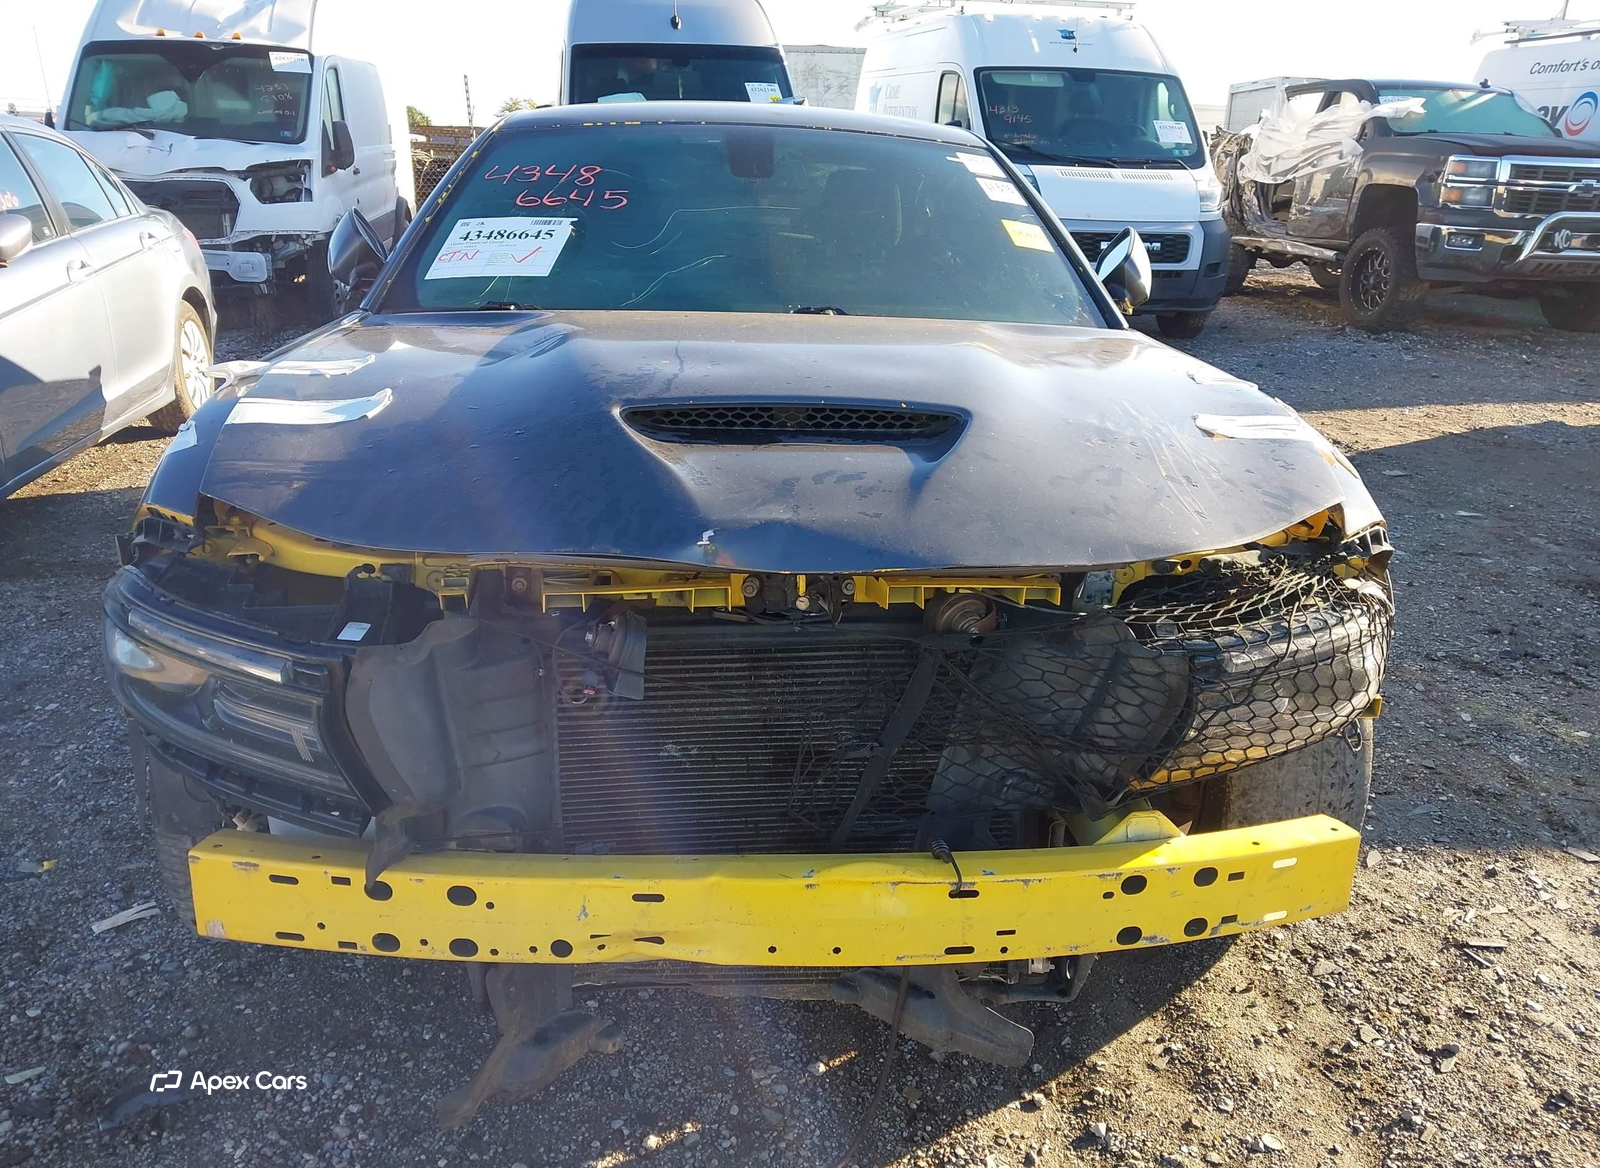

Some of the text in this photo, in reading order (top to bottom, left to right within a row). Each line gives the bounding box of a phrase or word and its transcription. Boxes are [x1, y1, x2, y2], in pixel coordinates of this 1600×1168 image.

[1530, 58, 1600, 74] Comfort's o
[989, 105, 1019, 114] 4313
[1004, 114, 1032, 123] 9145
[484, 164, 604, 186] 4348
[515, 189, 630, 210] 6645
[459, 229, 557, 242] 43486645
[1554, 229, 1571, 249] KC
